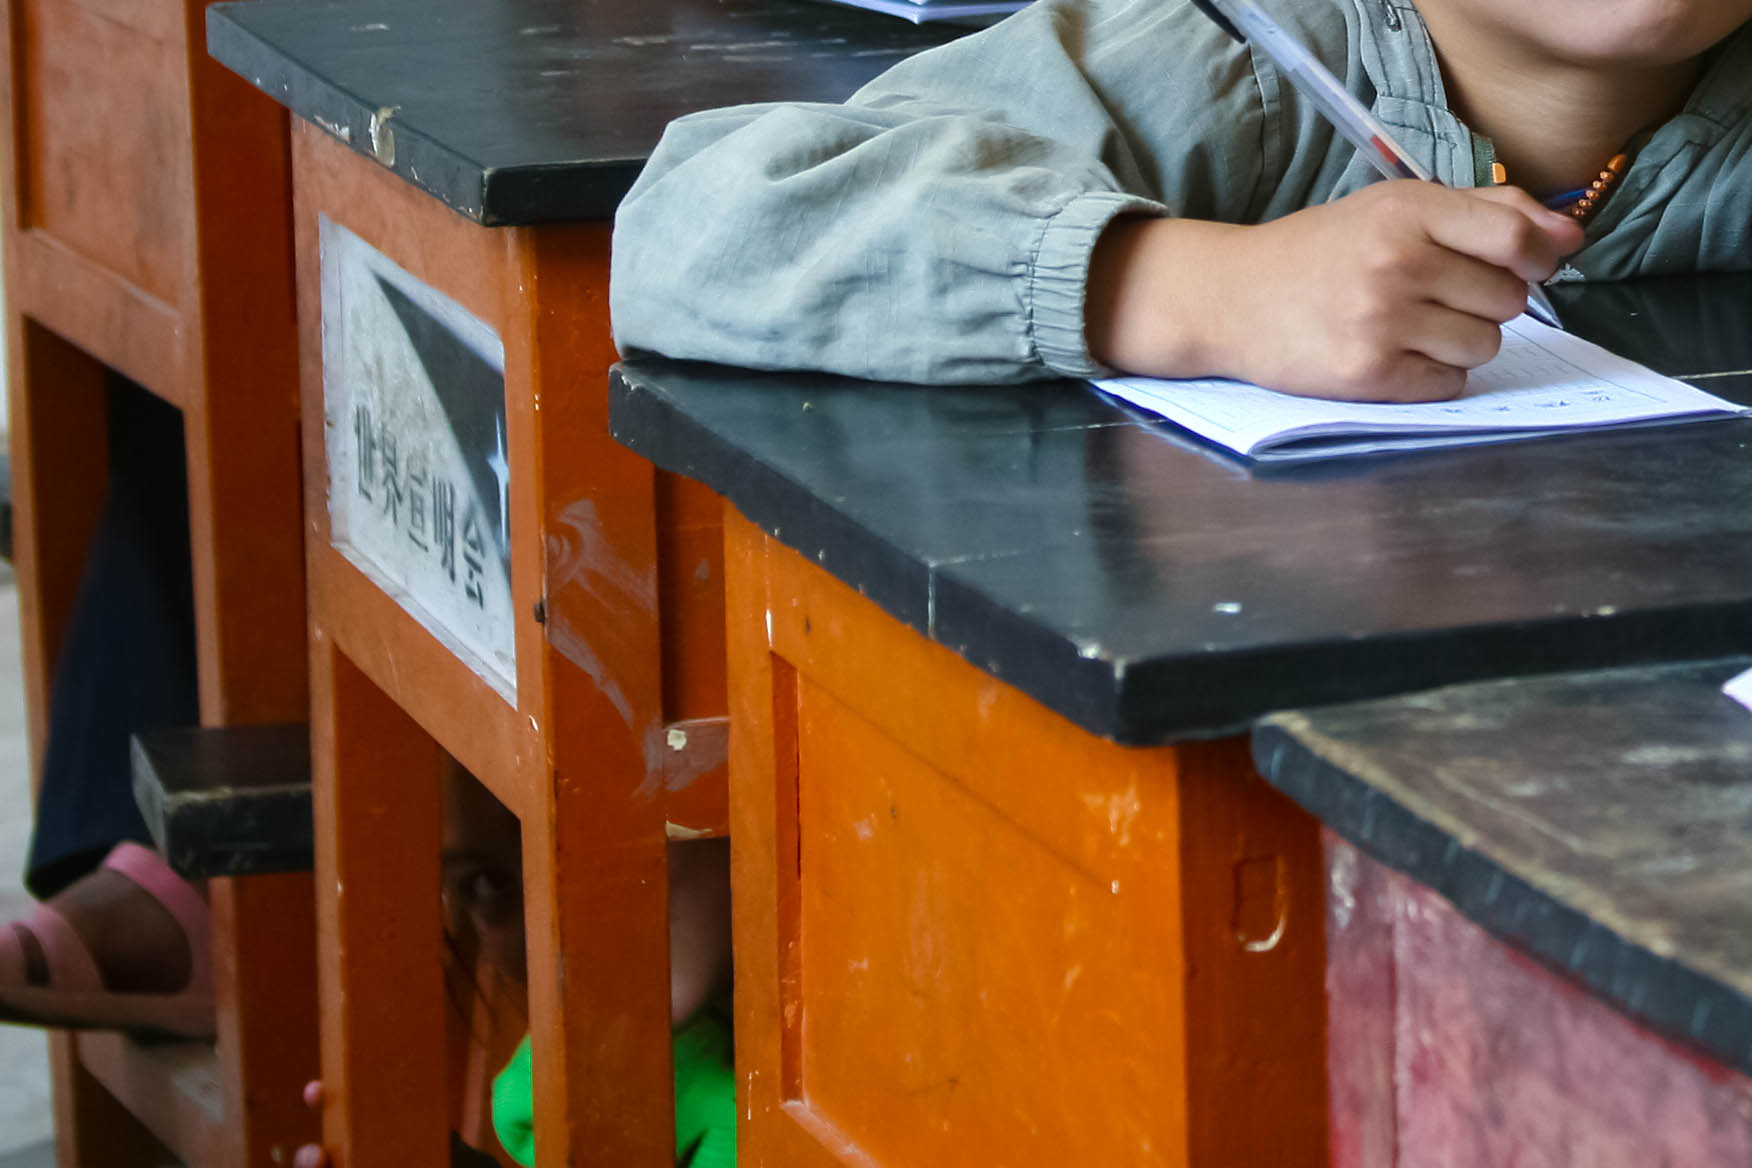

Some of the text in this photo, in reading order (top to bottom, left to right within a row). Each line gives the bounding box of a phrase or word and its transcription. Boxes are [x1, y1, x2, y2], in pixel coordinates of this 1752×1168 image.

[355, 404, 485, 610] 世界宣明会
